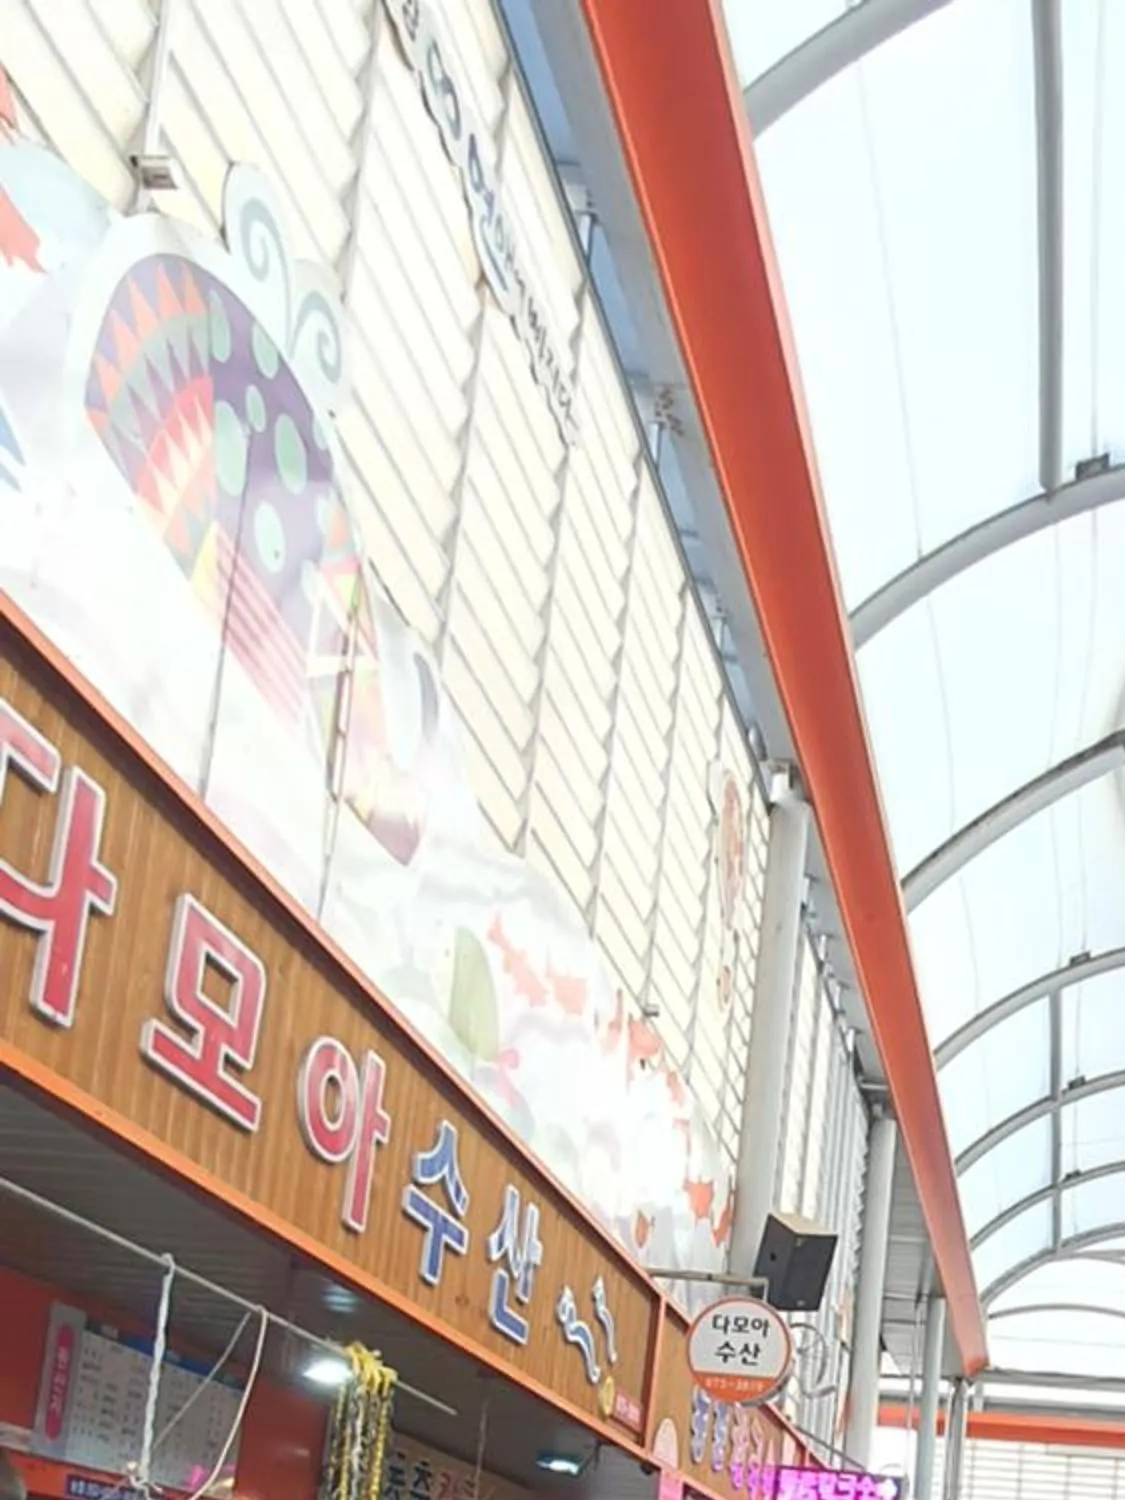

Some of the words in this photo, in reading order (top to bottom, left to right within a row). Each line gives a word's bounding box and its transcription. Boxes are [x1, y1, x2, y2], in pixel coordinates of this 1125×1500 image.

[0, 697, 390, 1233] 다모아
[403, 1119, 543, 1345] 수산
[712, 1313, 769, 1338] 다모아
[715, 1341, 761, 1366] 수산
